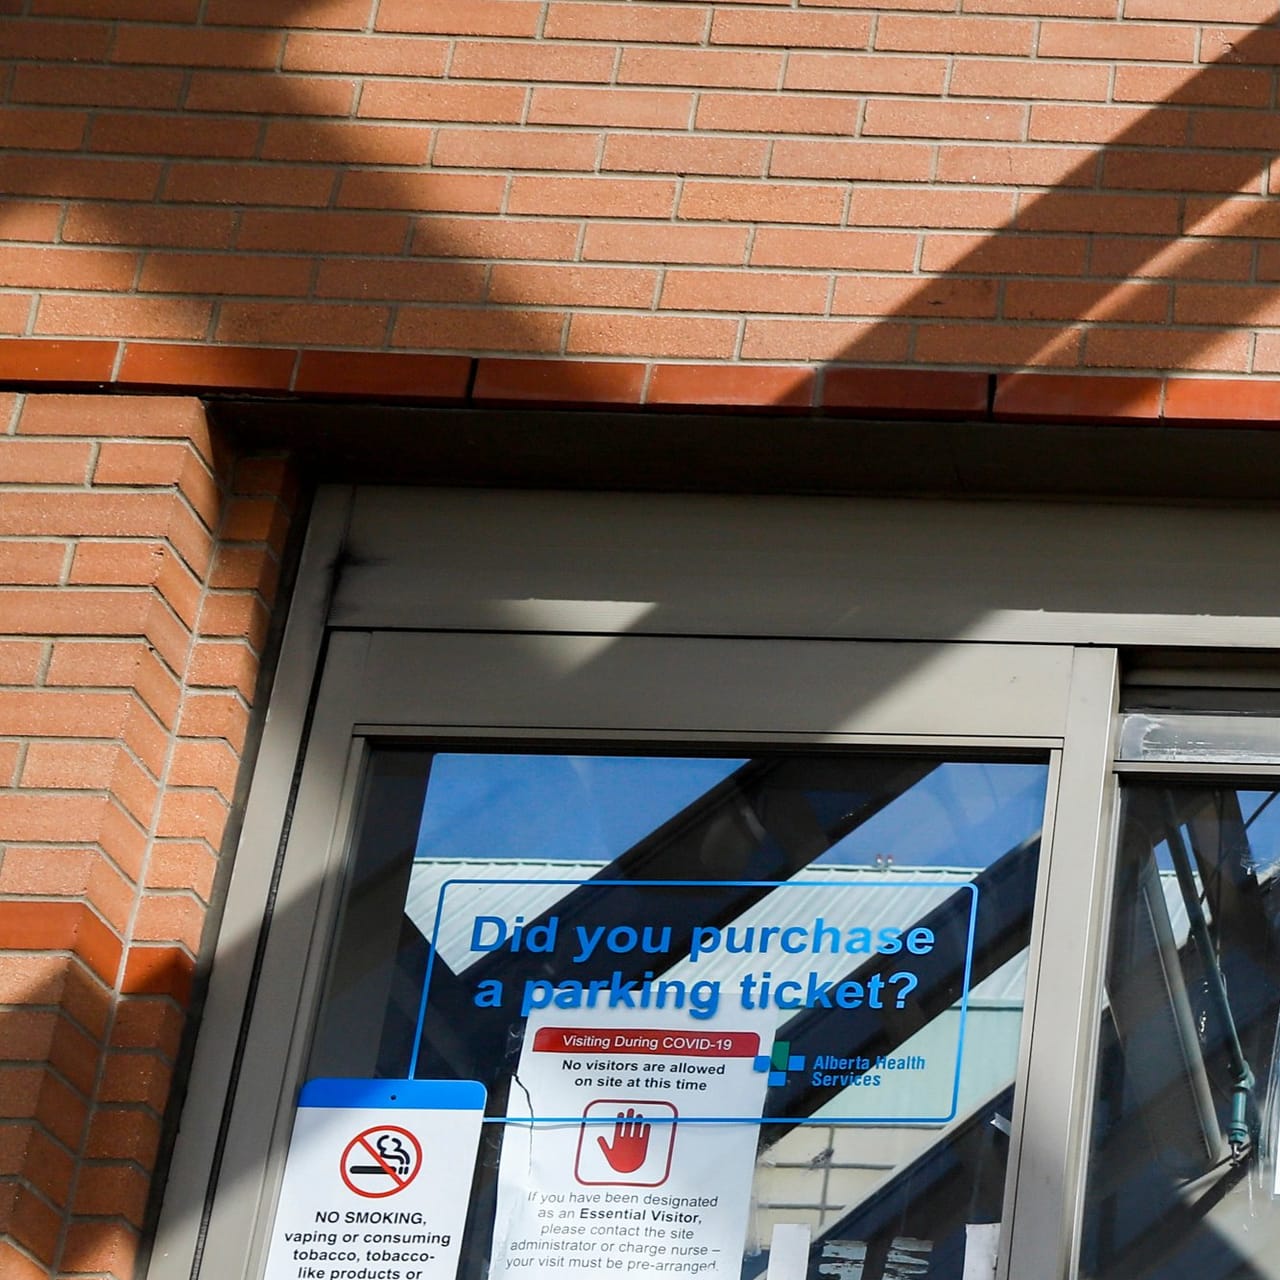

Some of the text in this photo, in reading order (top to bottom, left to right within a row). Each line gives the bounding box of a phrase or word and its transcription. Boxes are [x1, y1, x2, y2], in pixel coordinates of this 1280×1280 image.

[470, 915, 935, 963] Did you purchase
[474, 970, 918, 1020] a parking ticket?
[563, 1034, 732, 1051] Visiting During COVID-19
[562, 1059, 725, 1075] No visitors are allowed
[813, 1055, 926, 1071] Alberta Health
[575, 1076, 707, 1090] on site at this time
[811, 1072, 881, 1087] Services
[527, 1191, 718, 1209] If you have been designated
[315, 1211, 427, 1226] NO SMOKING,
[538, 1208, 703, 1224] as an Essential Visitor,
[284, 1230, 451, 1247] vaping or consuming
[293, 1249, 435, 1263] tobacco, tobacco-
[297, 1266, 423, 1280] like products or
